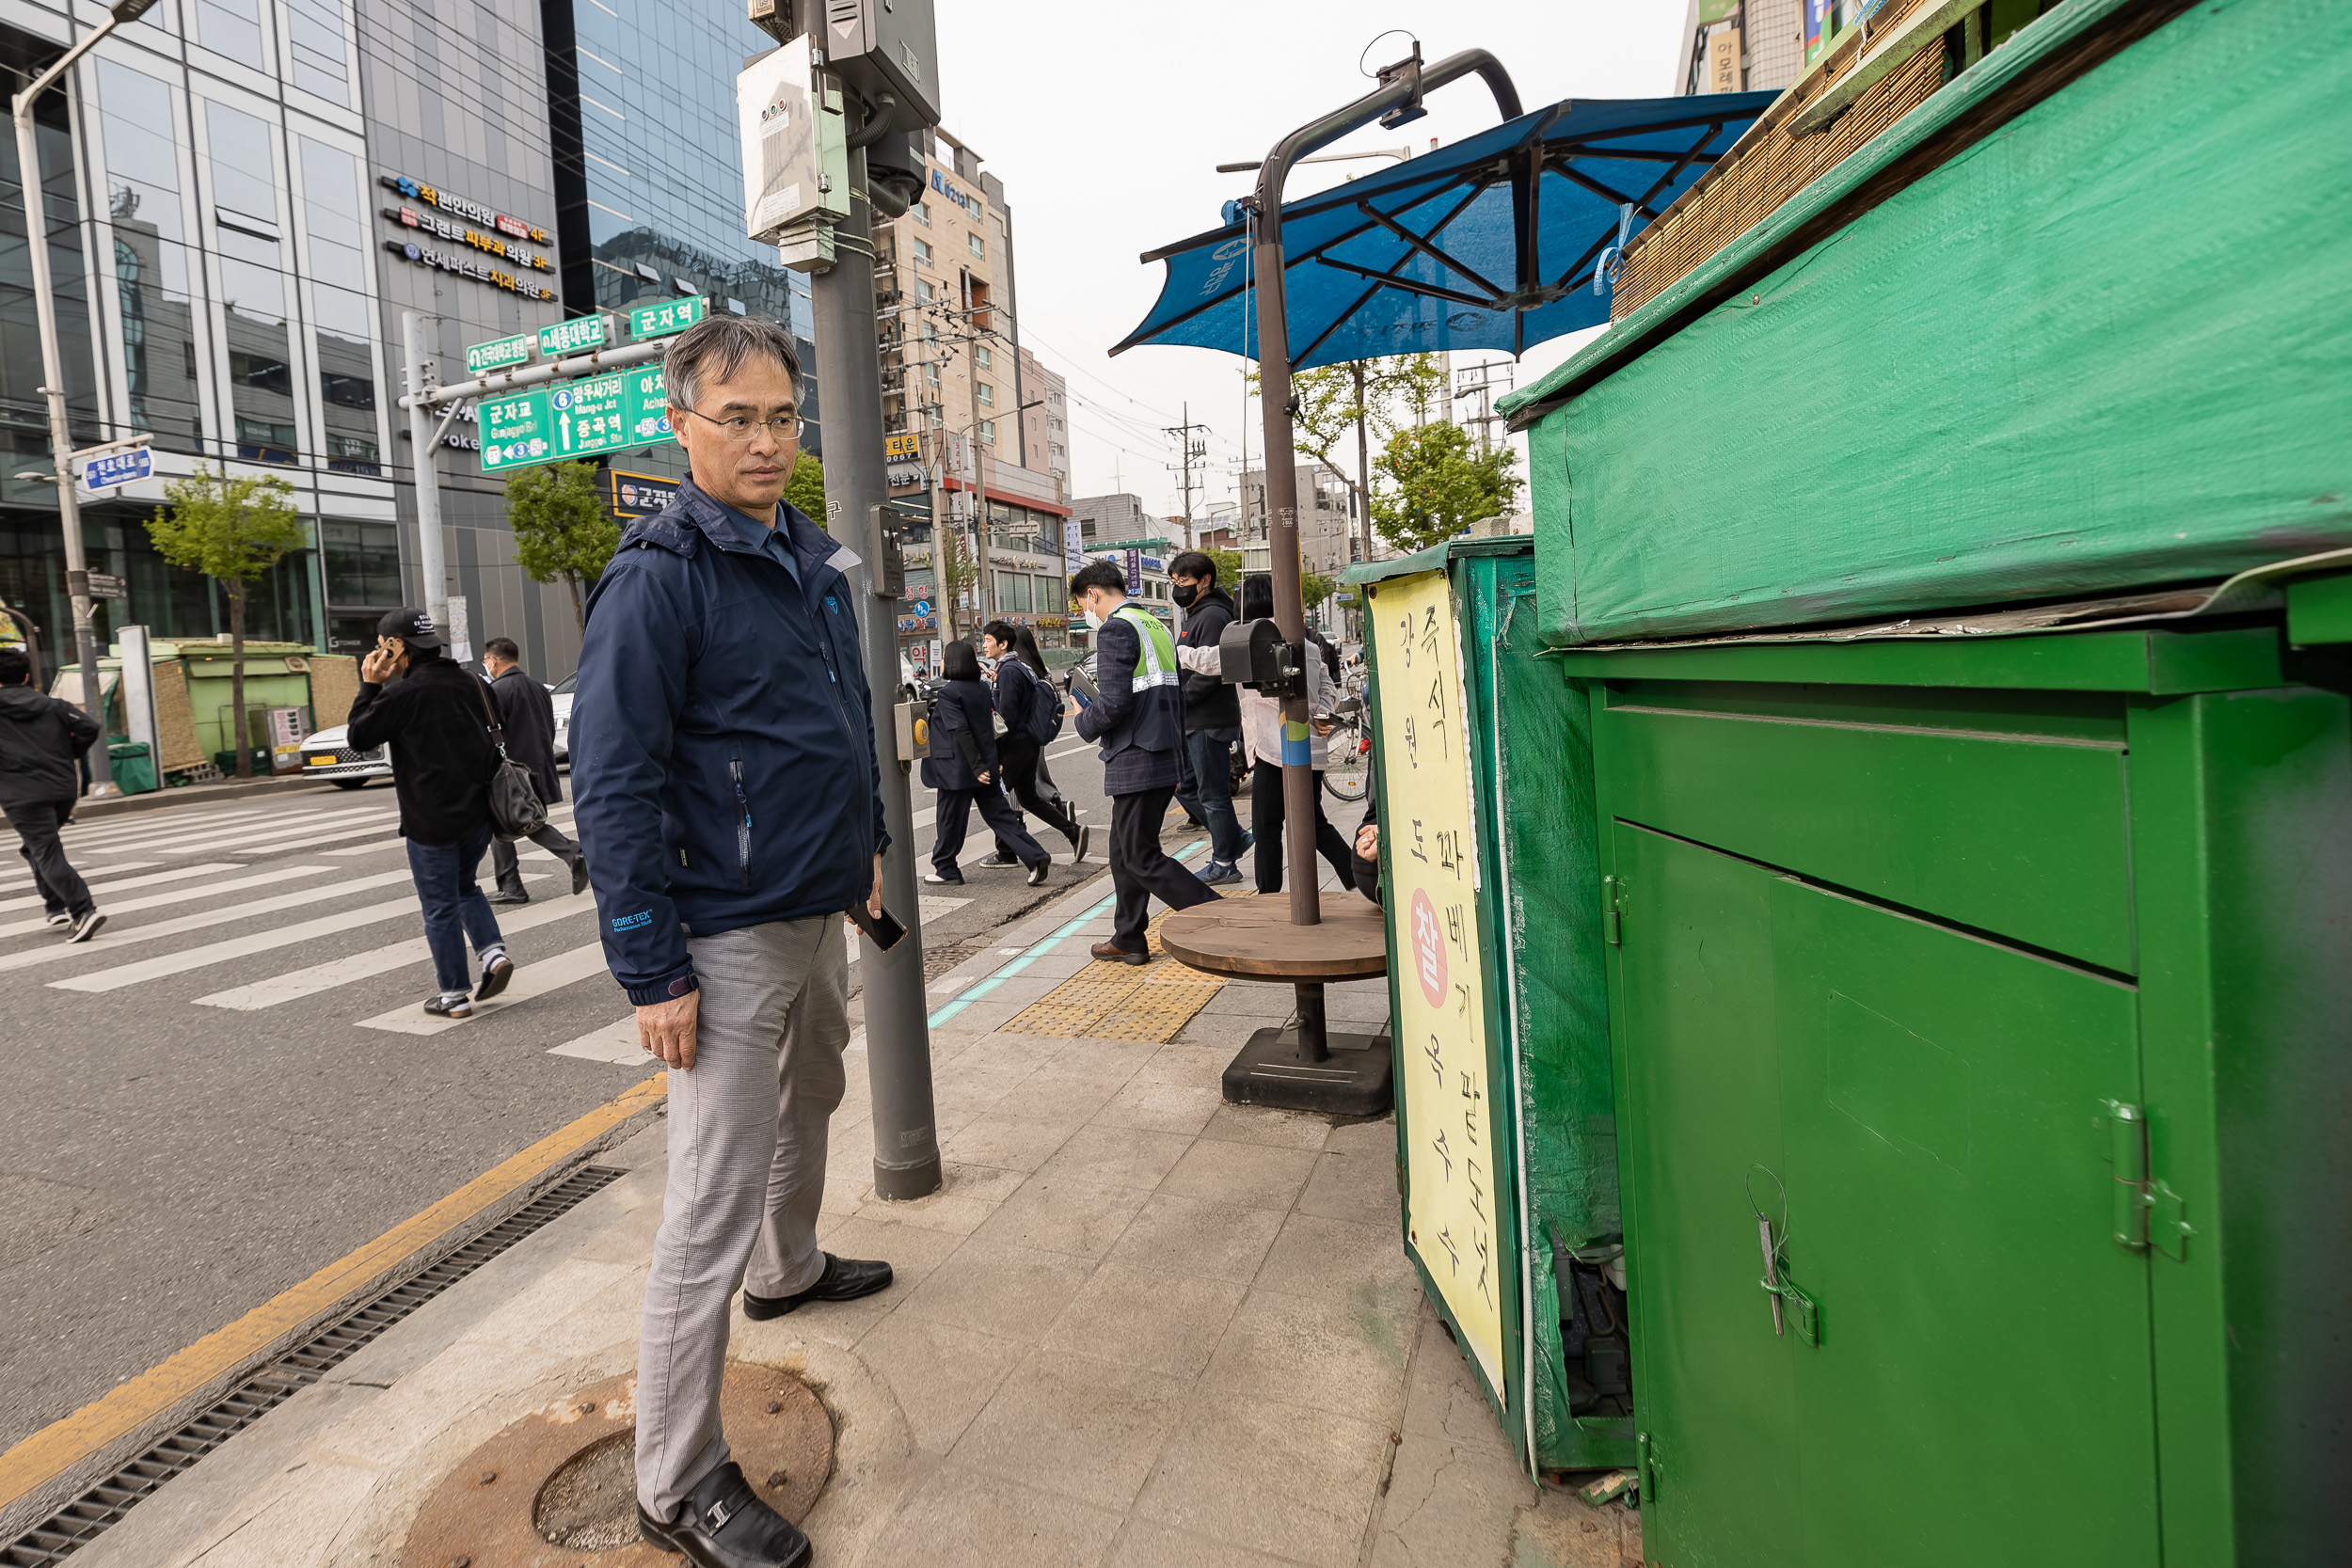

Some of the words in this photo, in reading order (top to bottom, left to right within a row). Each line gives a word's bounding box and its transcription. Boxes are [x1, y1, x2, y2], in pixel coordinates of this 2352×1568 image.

[420, 184, 496, 228] 척편안의원
[530, 228, 546, 242] 4F
[532, 254, 548, 269] 3F
[421, 246, 540, 300] 연세퍼스트치과의원
[539, 287, 552, 300] 3F
[640, 302, 692, 331] 군자역
[549, 319, 602, 351] 세종대학교
[558, 392, 568, 407] 6
[573, 377, 623, 404] 망우사거리
[489, 402, 532, 424] 군자교
[575, 403, 602, 415] Mang-u
[604, 399, 617, 410] Jct
[577, 413, 622, 438] 중곡역
[661, 418, 671, 431] 3
[516, 444, 525, 456] 3
[97, 454, 136, 476] 천호대로
[905, 585, 929, 600] 성형
[912, 645, 927, 666] 약
[613, 923, 641, 933] Performance
[641, 919, 653, 927] Shell
